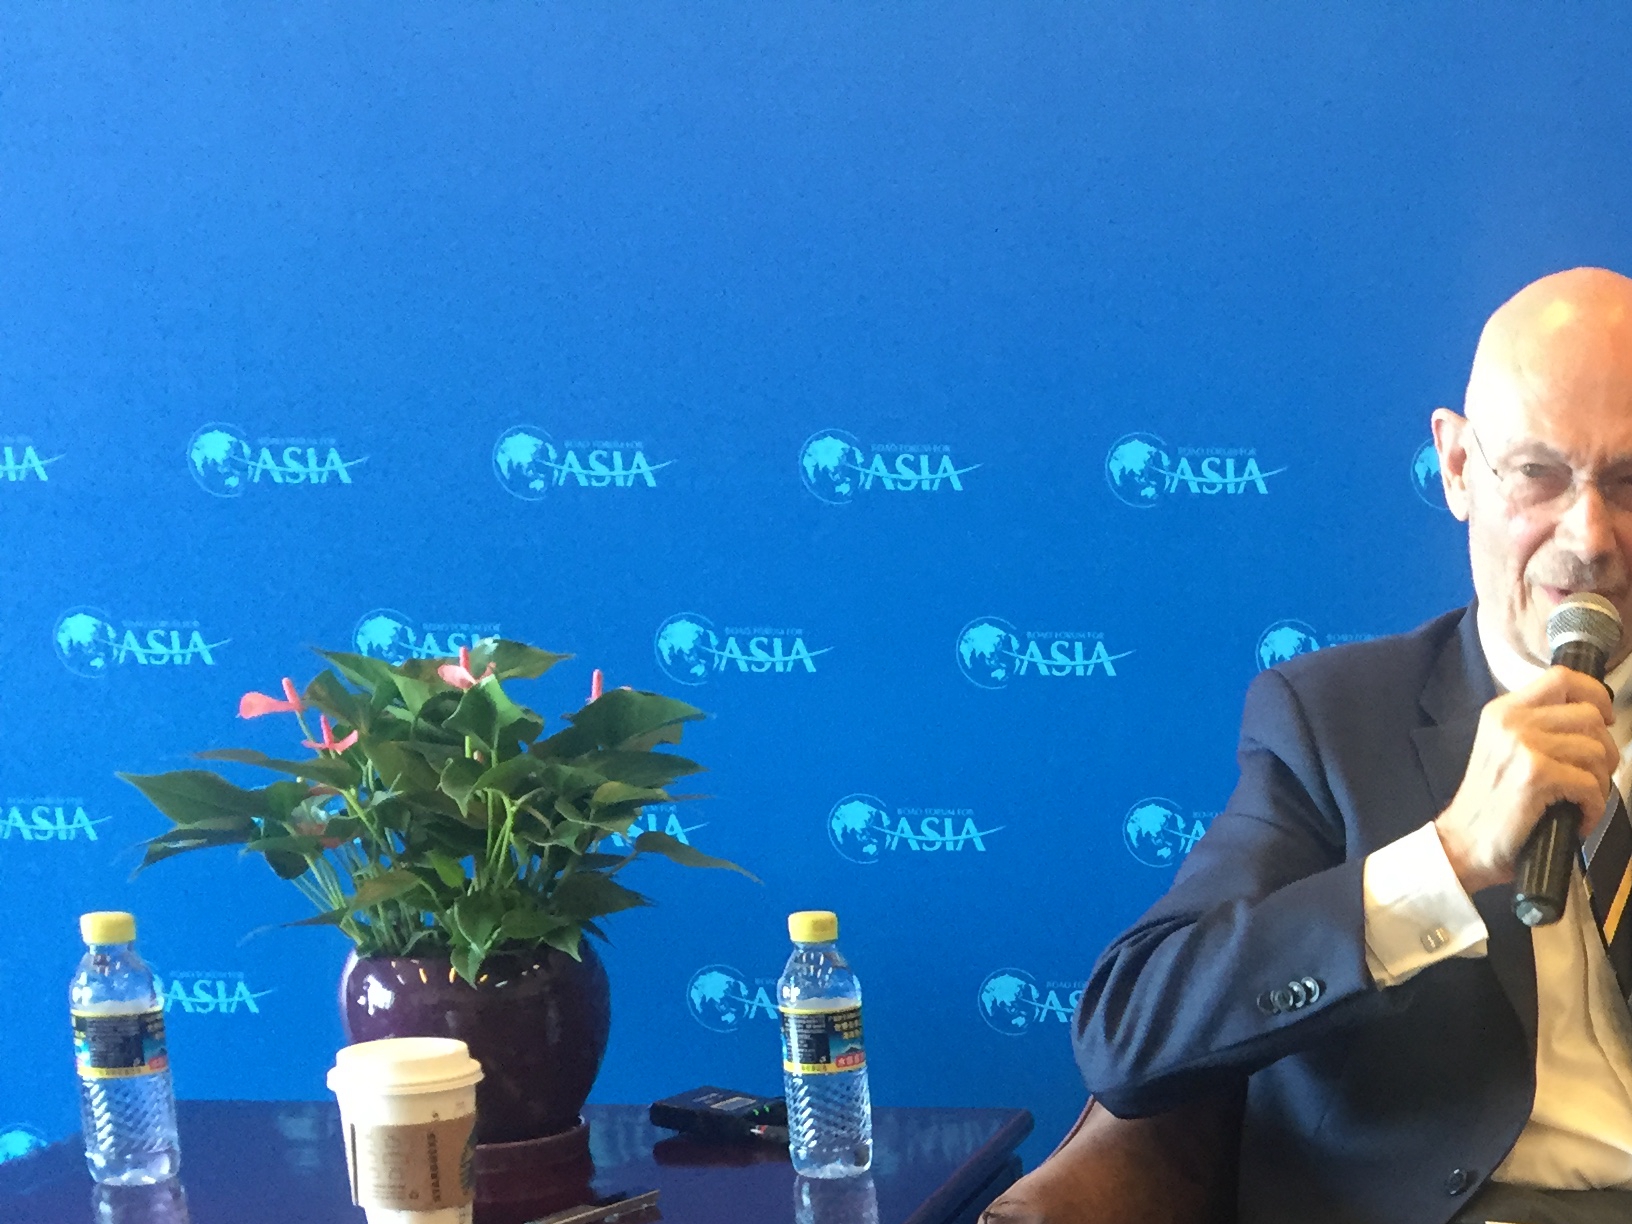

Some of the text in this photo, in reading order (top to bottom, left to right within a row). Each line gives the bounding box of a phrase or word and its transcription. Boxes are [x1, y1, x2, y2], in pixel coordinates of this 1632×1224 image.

[0, 446, 48, 482] IA
[253, 447, 352, 484] ASIA
[558, 449, 657, 488] ASIA
[864, 453, 963, 491] ASIA
[1169, 456, 1269, 495] ASIA
[118, 629, 215, 665] ASIA
[420, 632, 501, 660] AS
[718, 636, 817, 673] ASIA
[1019, 640, 1117, 677] ASIA
[3, 805, 98, 841] ASIA
[890, 816, 986, 851] ASIA
[165, 979, 260, 1014] ASIA
